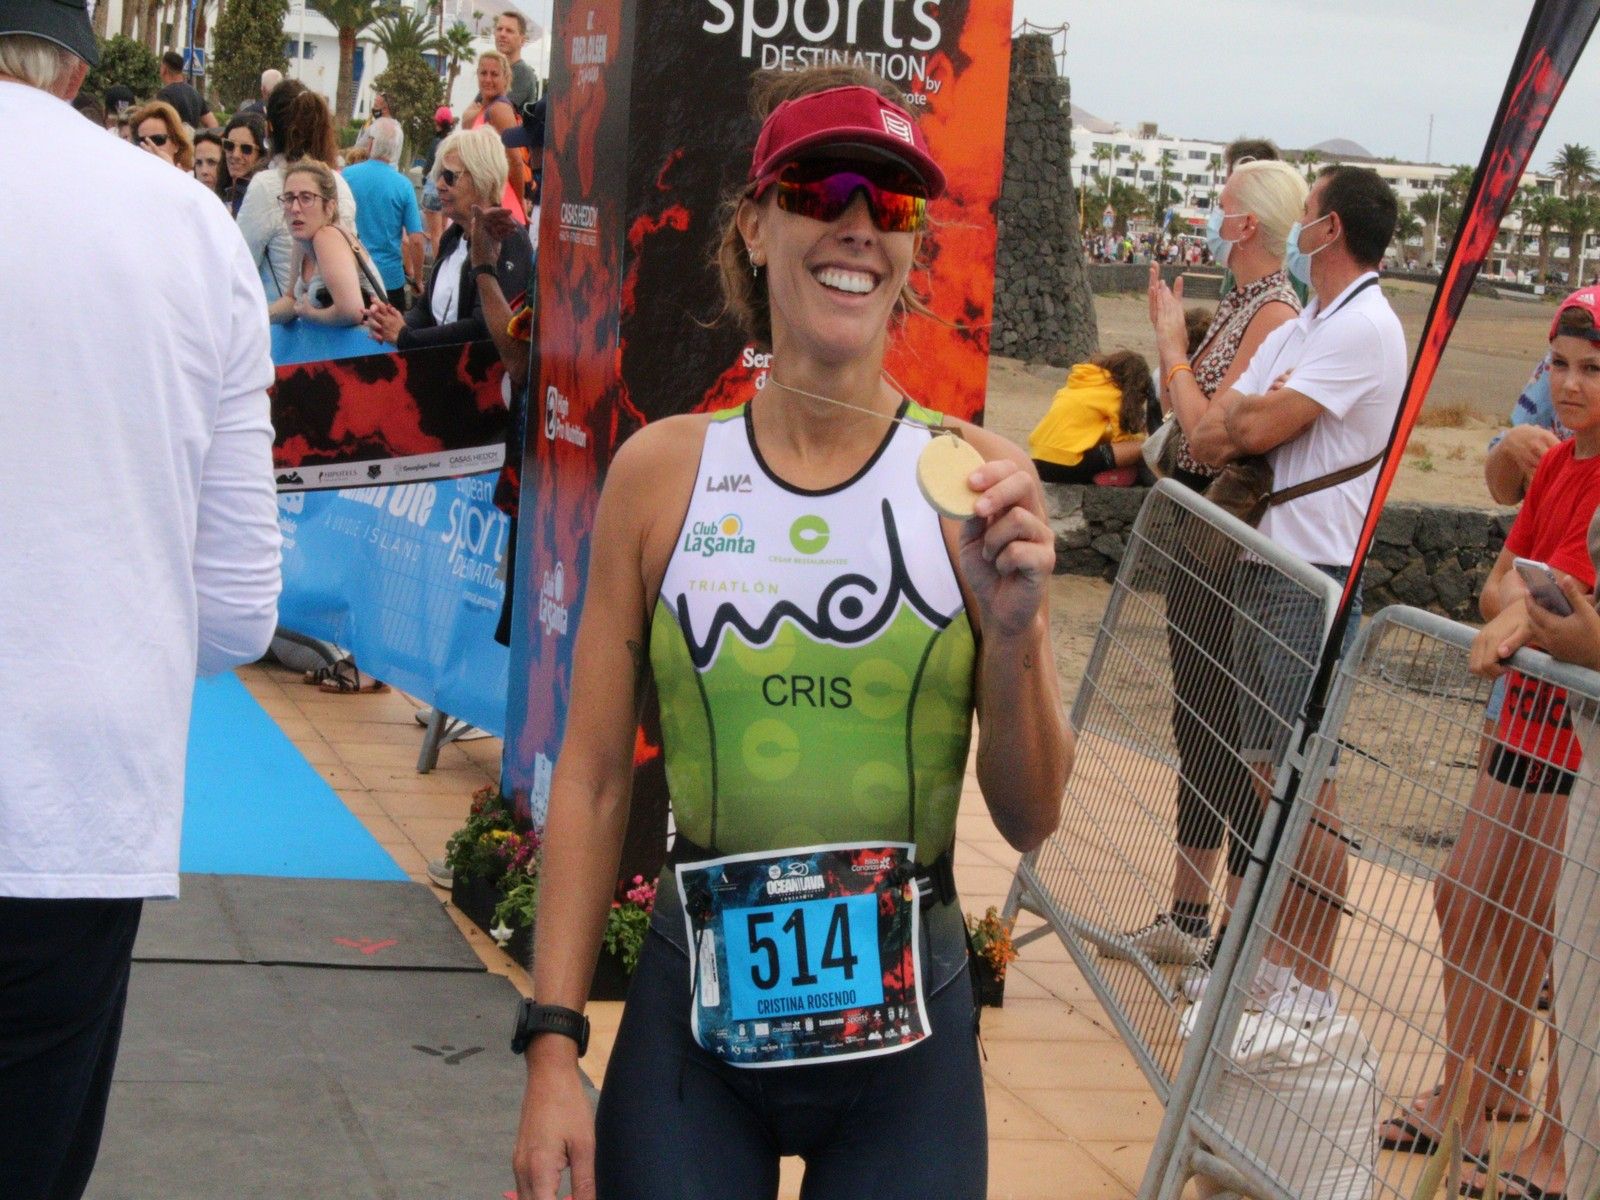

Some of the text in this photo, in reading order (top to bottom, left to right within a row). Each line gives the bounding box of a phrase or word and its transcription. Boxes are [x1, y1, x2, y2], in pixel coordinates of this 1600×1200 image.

[702, 0, 942, 58] sports
[926, 78, 942, 93] by
[706, 474, 753, 493] LAVA
[692, 521, 718, 536] Club
[688, 578, 779, 595] TRIATLÓN
[762, 674, 853, 709] CRIS
[746, 902, 858, 991] 514
[757, 989, 857, 1015] CRISTINA ROSENDO
